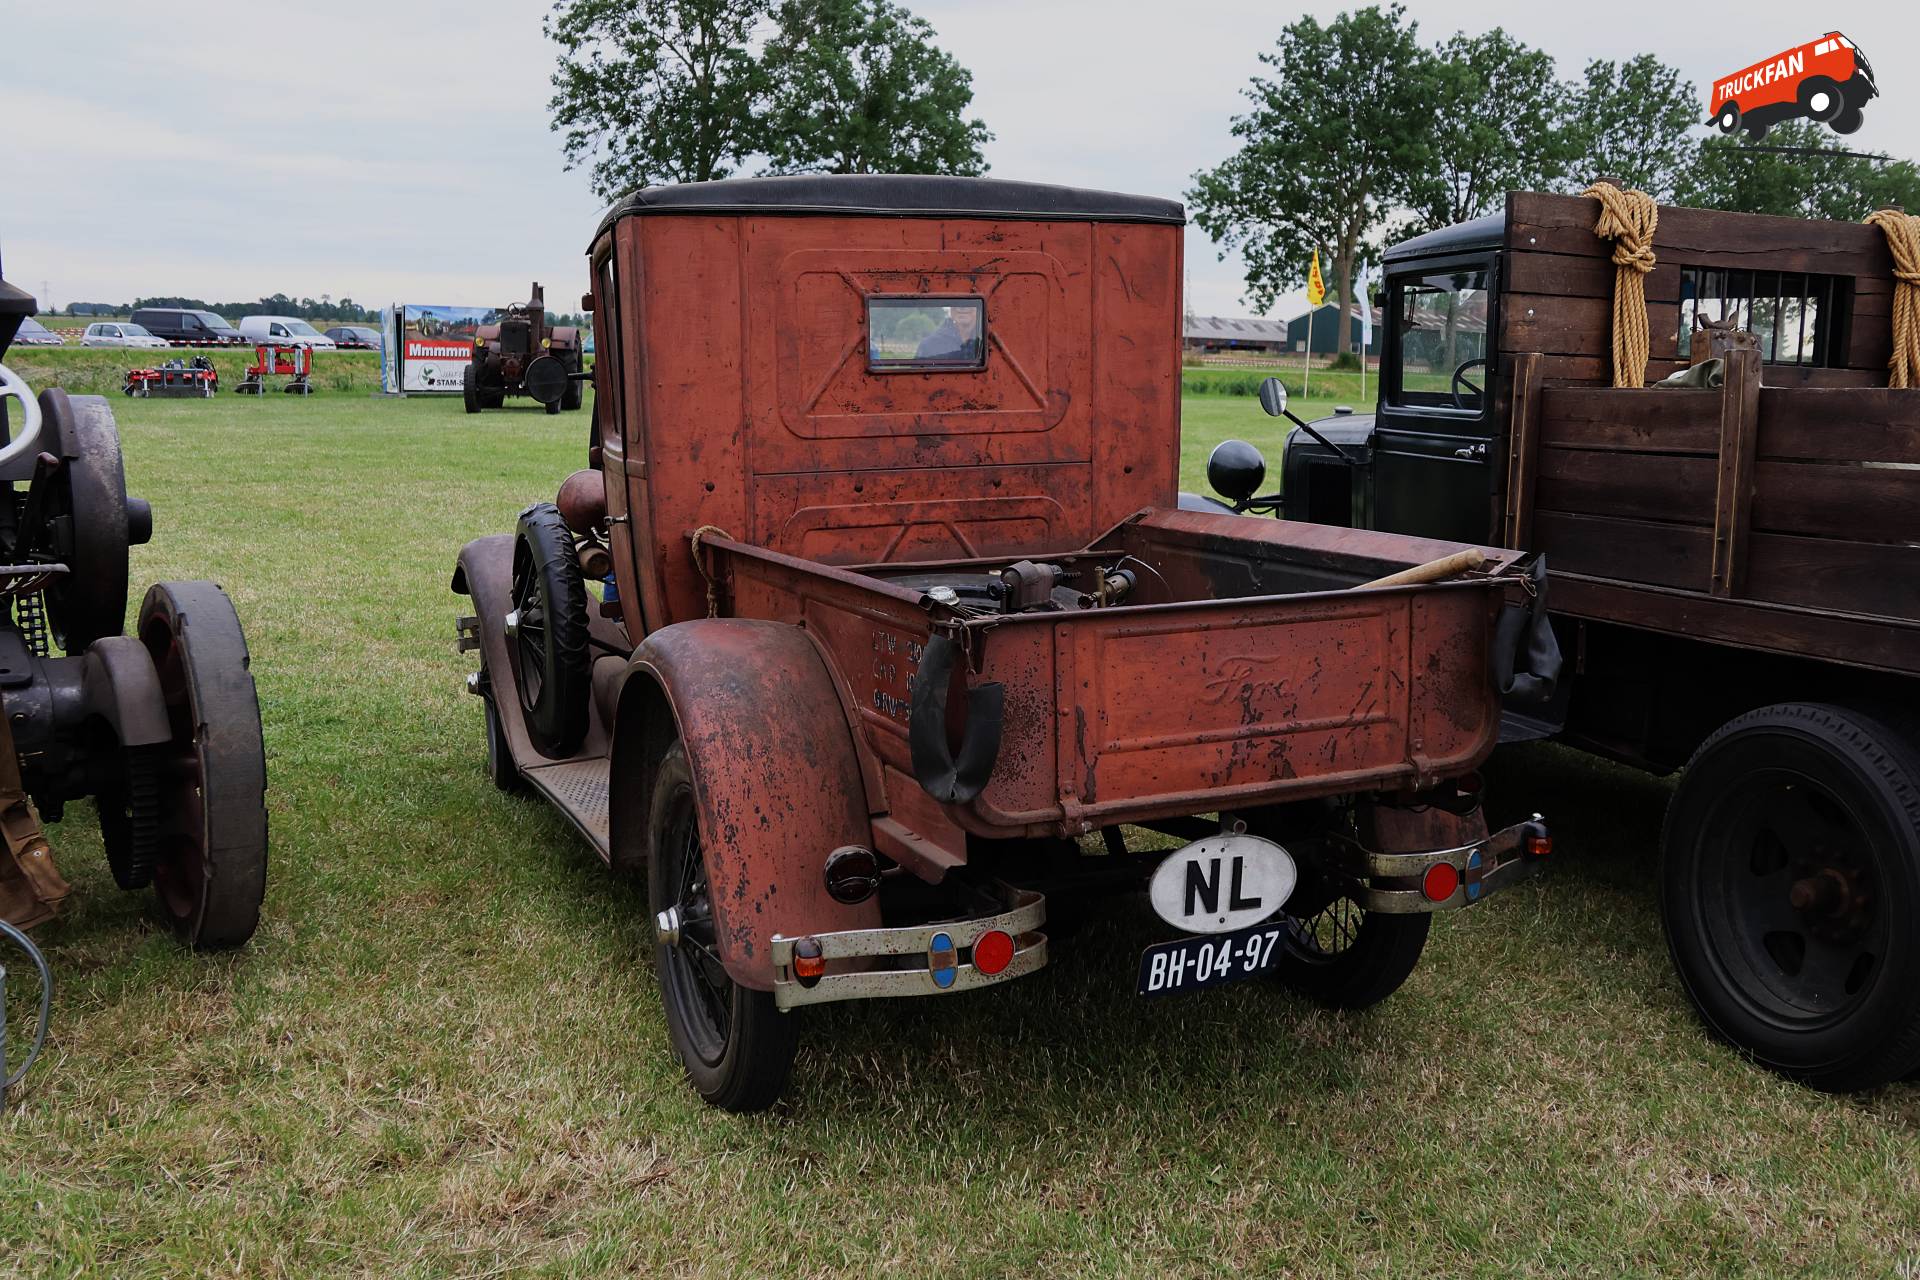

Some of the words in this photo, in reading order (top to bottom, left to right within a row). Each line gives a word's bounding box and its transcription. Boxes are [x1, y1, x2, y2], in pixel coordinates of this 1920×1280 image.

[409, 343, 470, 358] Mmmmm
[1184, 856, 1262, 917] NL
[1148, 930, 1280, 991] BH-04-97
